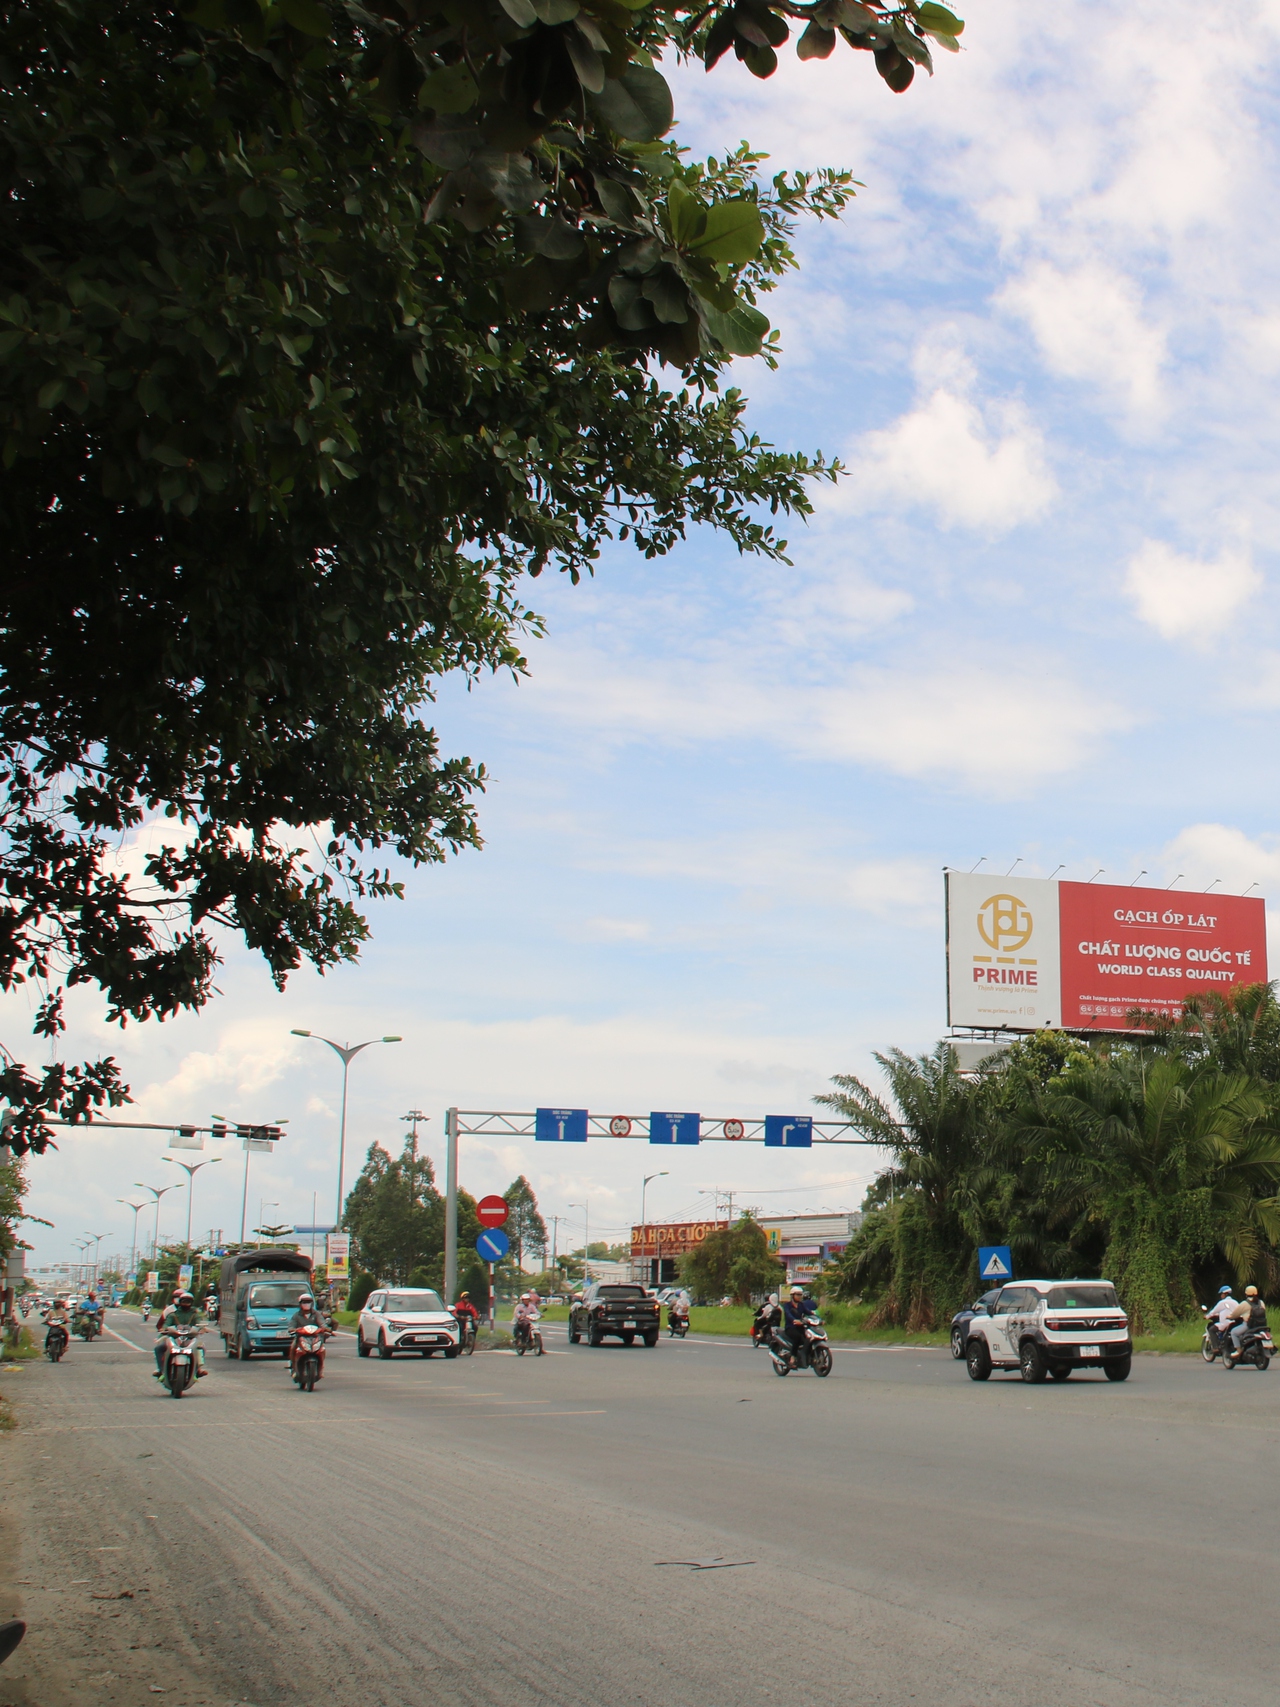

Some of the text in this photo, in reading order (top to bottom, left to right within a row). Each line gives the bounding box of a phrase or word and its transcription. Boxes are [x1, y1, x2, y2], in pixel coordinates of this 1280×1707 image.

[1113, 908, 1217, 928] GẠCH ỐP LÁT
[1078, 939, 1251, 966] CHẤT LƯỢNG QUỐC TẾ
[973, 967, 1038, 986] PRIME
[1097, 963, 1235, 981] WORLD CLASS QUALITY
[977, 1007, 1017, 1015] www.prime.vn
[648, 1227, 676, 1243] HOA
